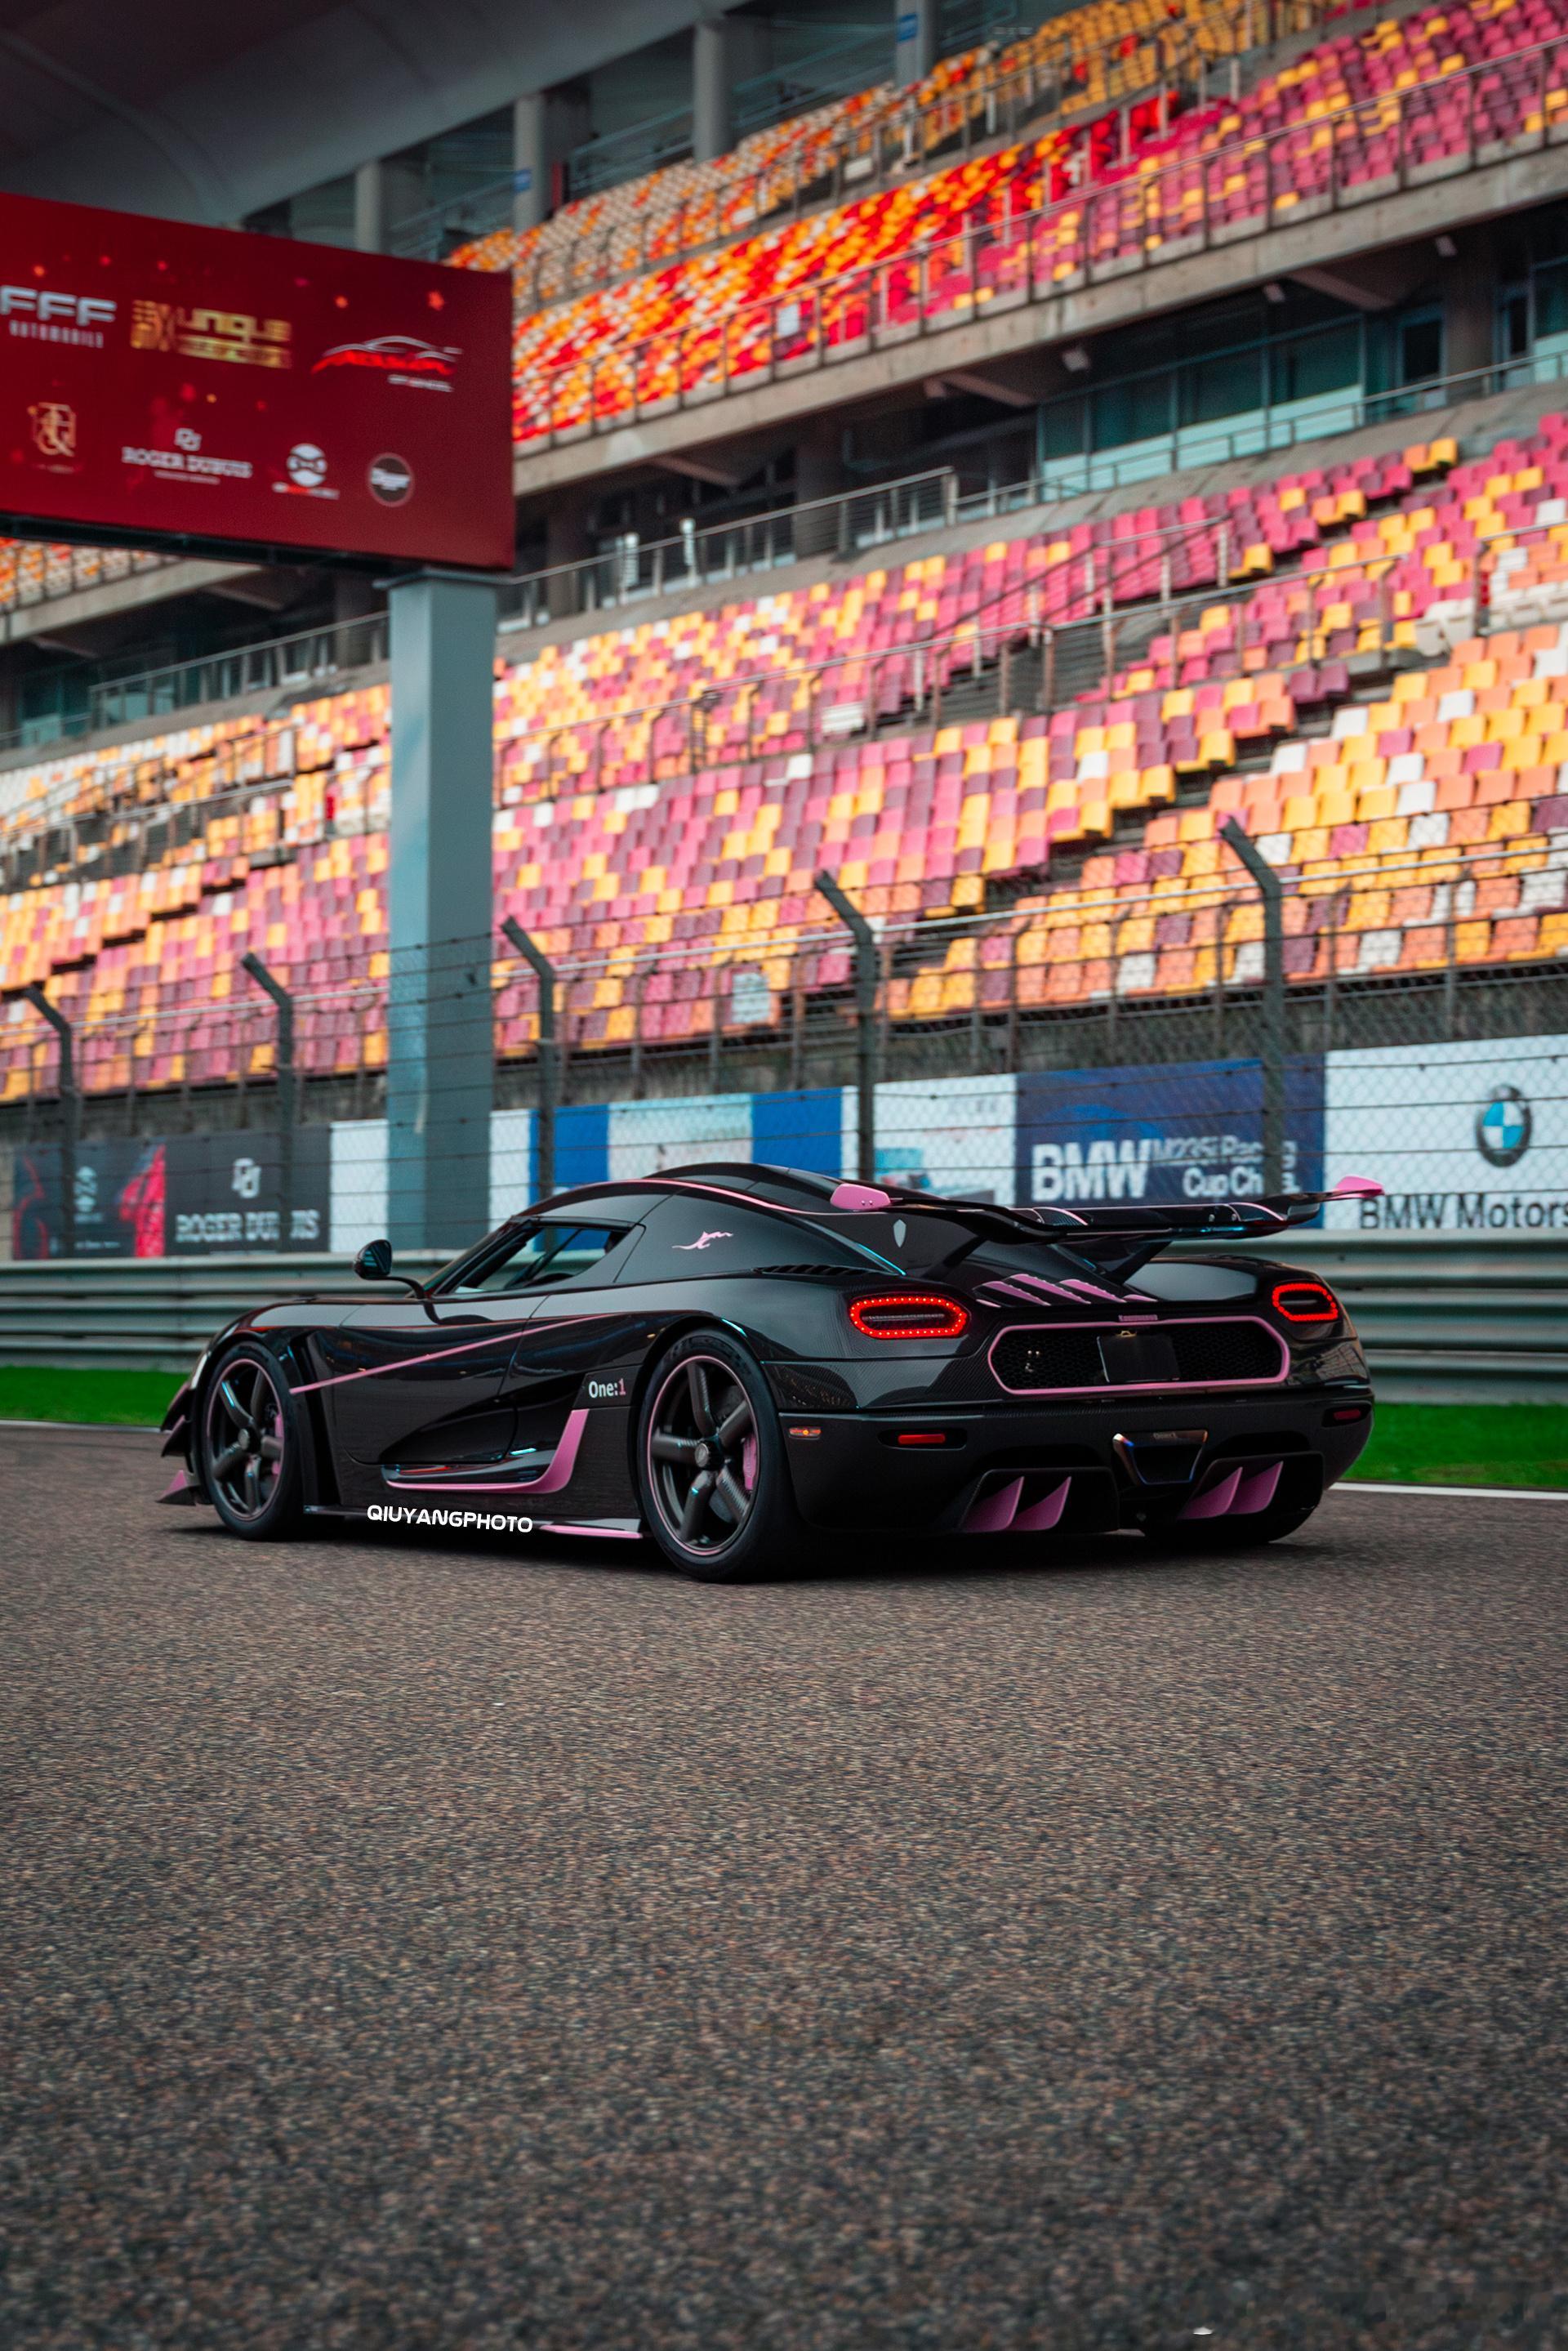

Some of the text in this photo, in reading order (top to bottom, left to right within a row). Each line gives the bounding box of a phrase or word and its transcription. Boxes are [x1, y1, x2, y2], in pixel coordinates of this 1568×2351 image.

[0, 285, 117, 327] FFF
[1031, 1139, 1152, 1202] BMW
[174, 1213, 243, 1242] ROGER
[1360, 1193, 1447, 1229] BMW
[588, 1377, 626, 1399] One:1
